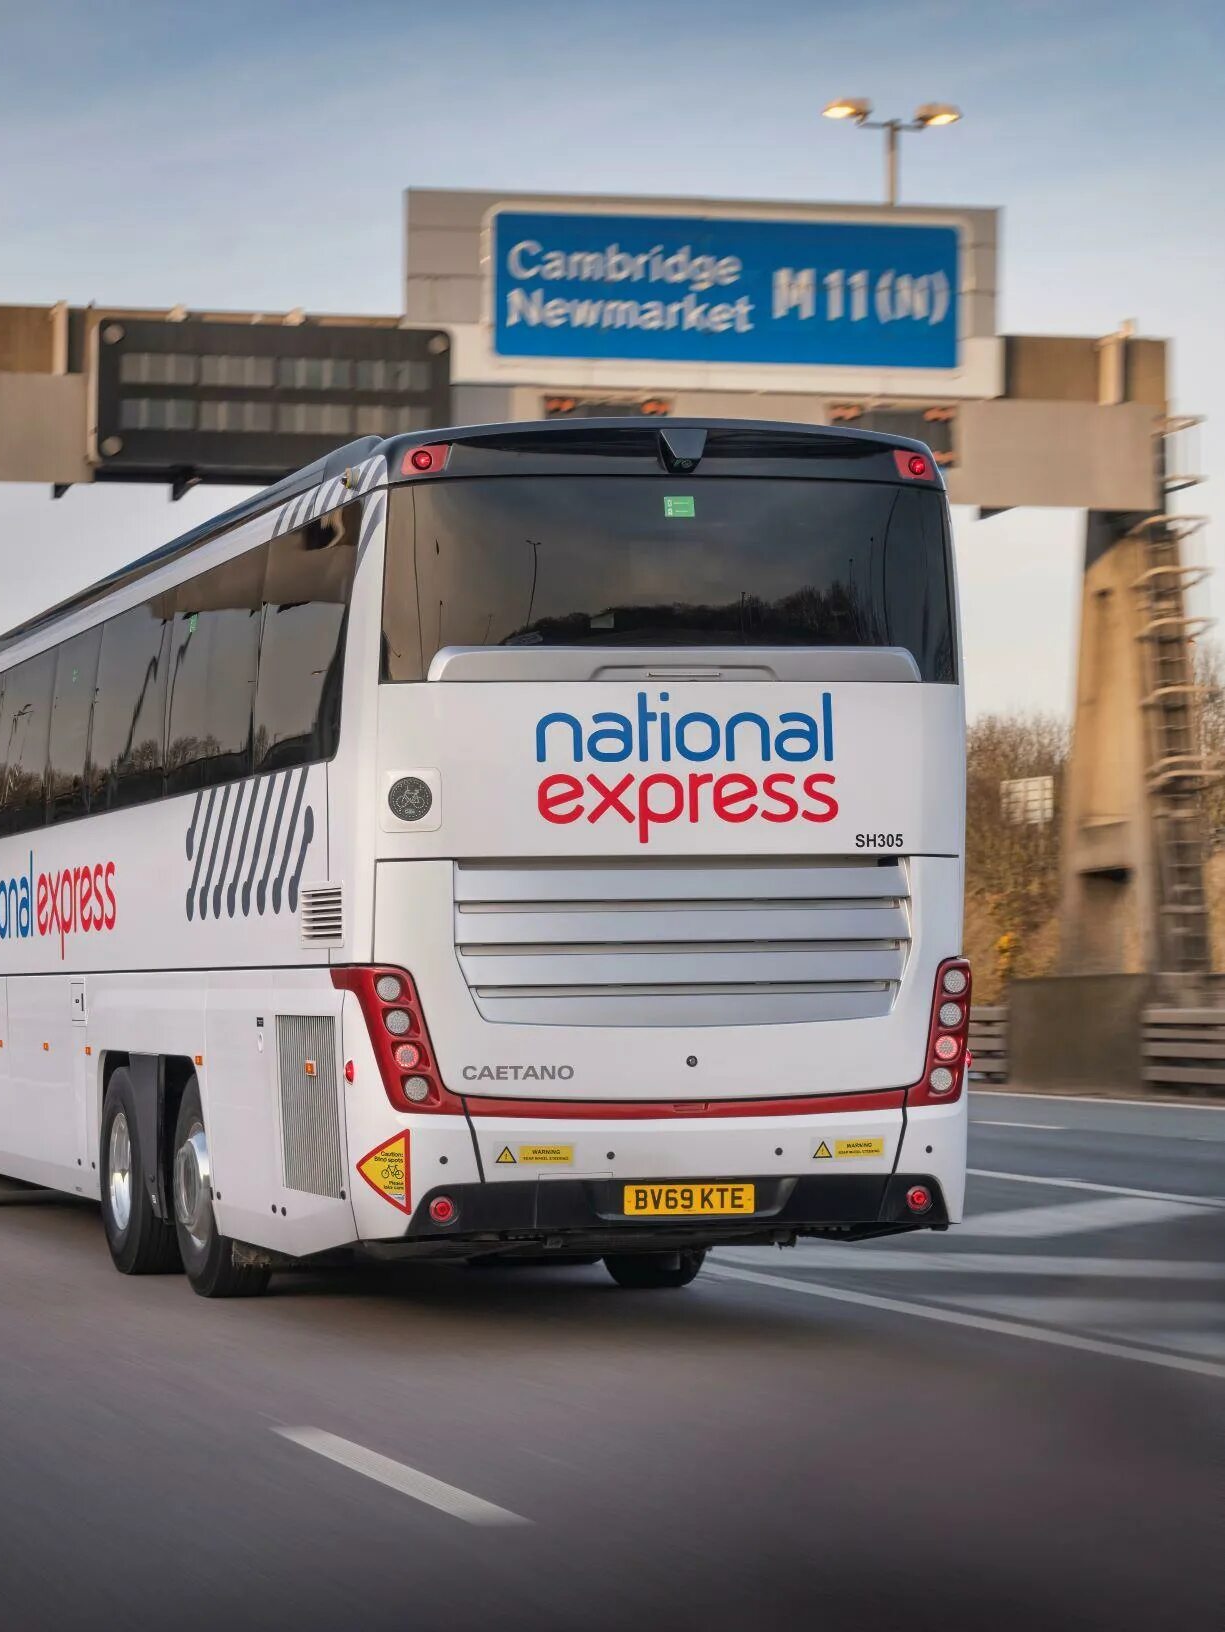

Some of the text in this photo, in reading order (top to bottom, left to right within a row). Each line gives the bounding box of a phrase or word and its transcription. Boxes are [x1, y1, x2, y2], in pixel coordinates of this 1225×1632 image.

[507, 239, 742, 292] Cambridge
[506, 287, 755, 333] Newmarket
[535, 691, 834, 763] national
[537, 772, 839, 844] express
[855, 833, 904, 848] SH305
[36, 861, 117, 961] express
[462, 1065, 575, 1081] CAETANO
[634, 1187, 744, 1210] BV69 KTE
